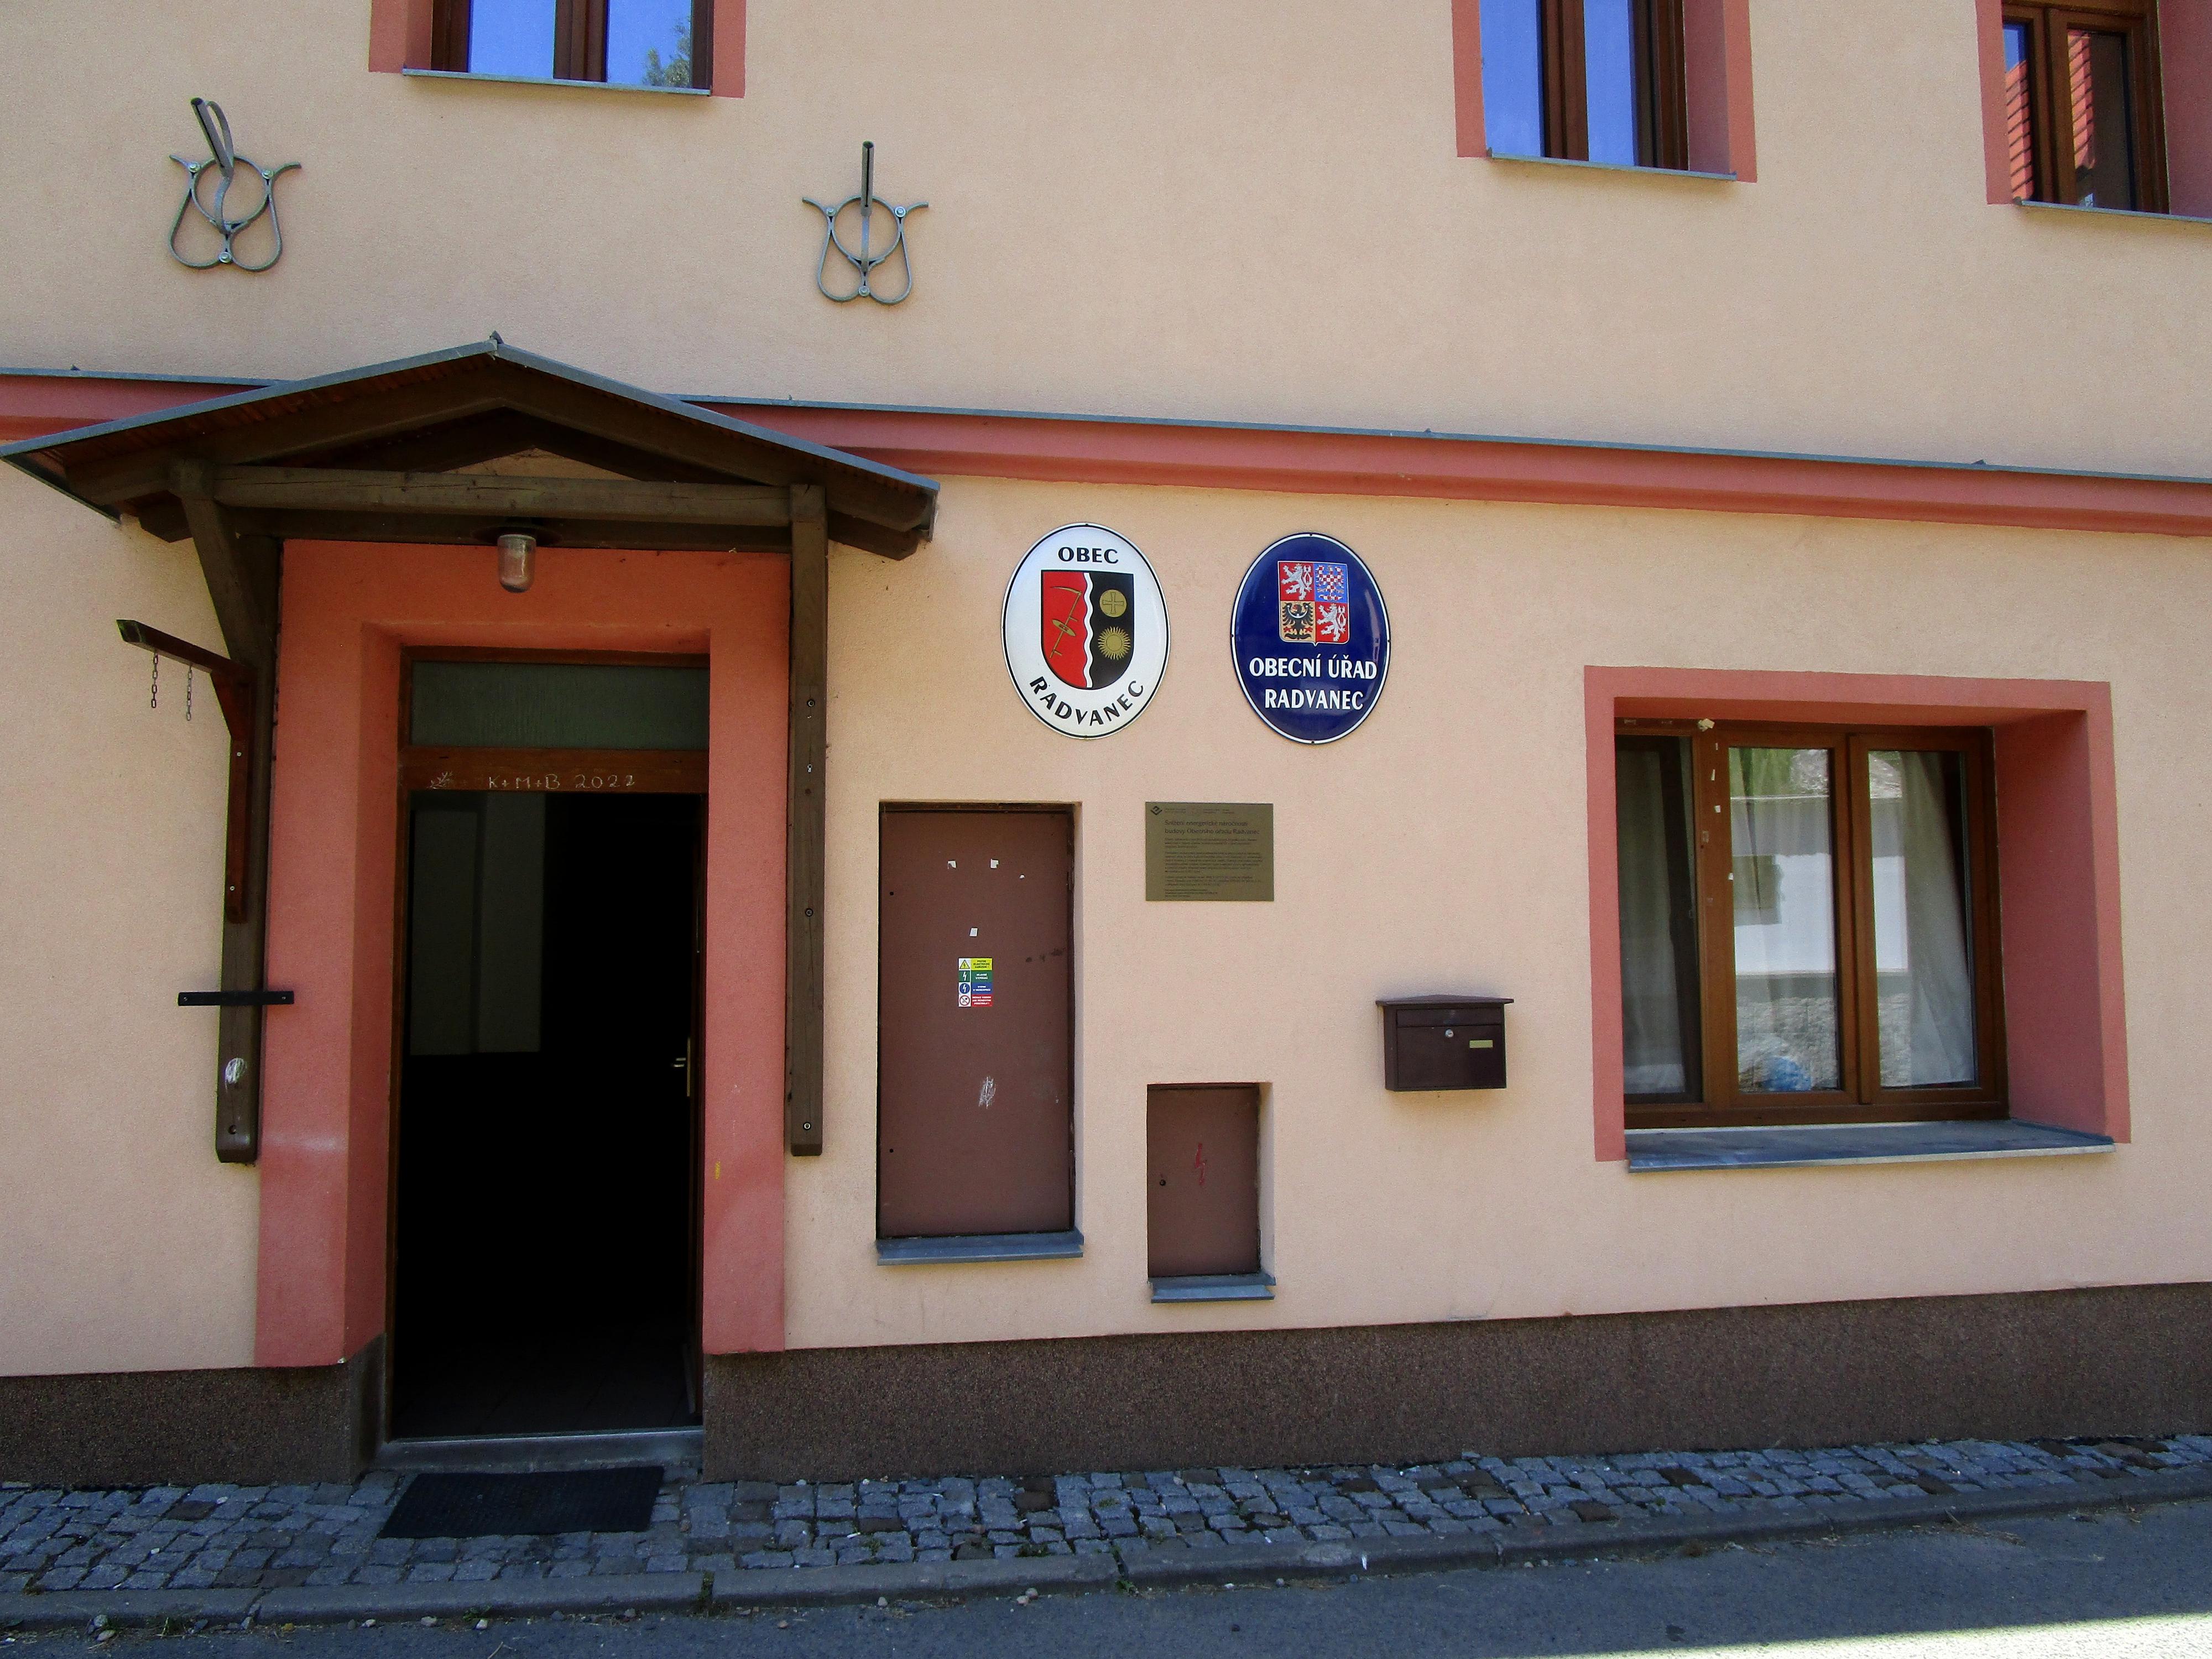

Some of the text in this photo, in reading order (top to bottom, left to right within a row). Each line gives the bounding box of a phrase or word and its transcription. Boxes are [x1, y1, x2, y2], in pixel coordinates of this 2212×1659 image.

[1058, 546, 1119, 564] OBEC
[1249, 654, 1377, 680] OBECNÍ ÚŘAD
[1030, 676, 1144, 726] RADVANEC
[1265, 689, 1363, 710] RADVANEC
[575, 774, 635, 789] 2022
